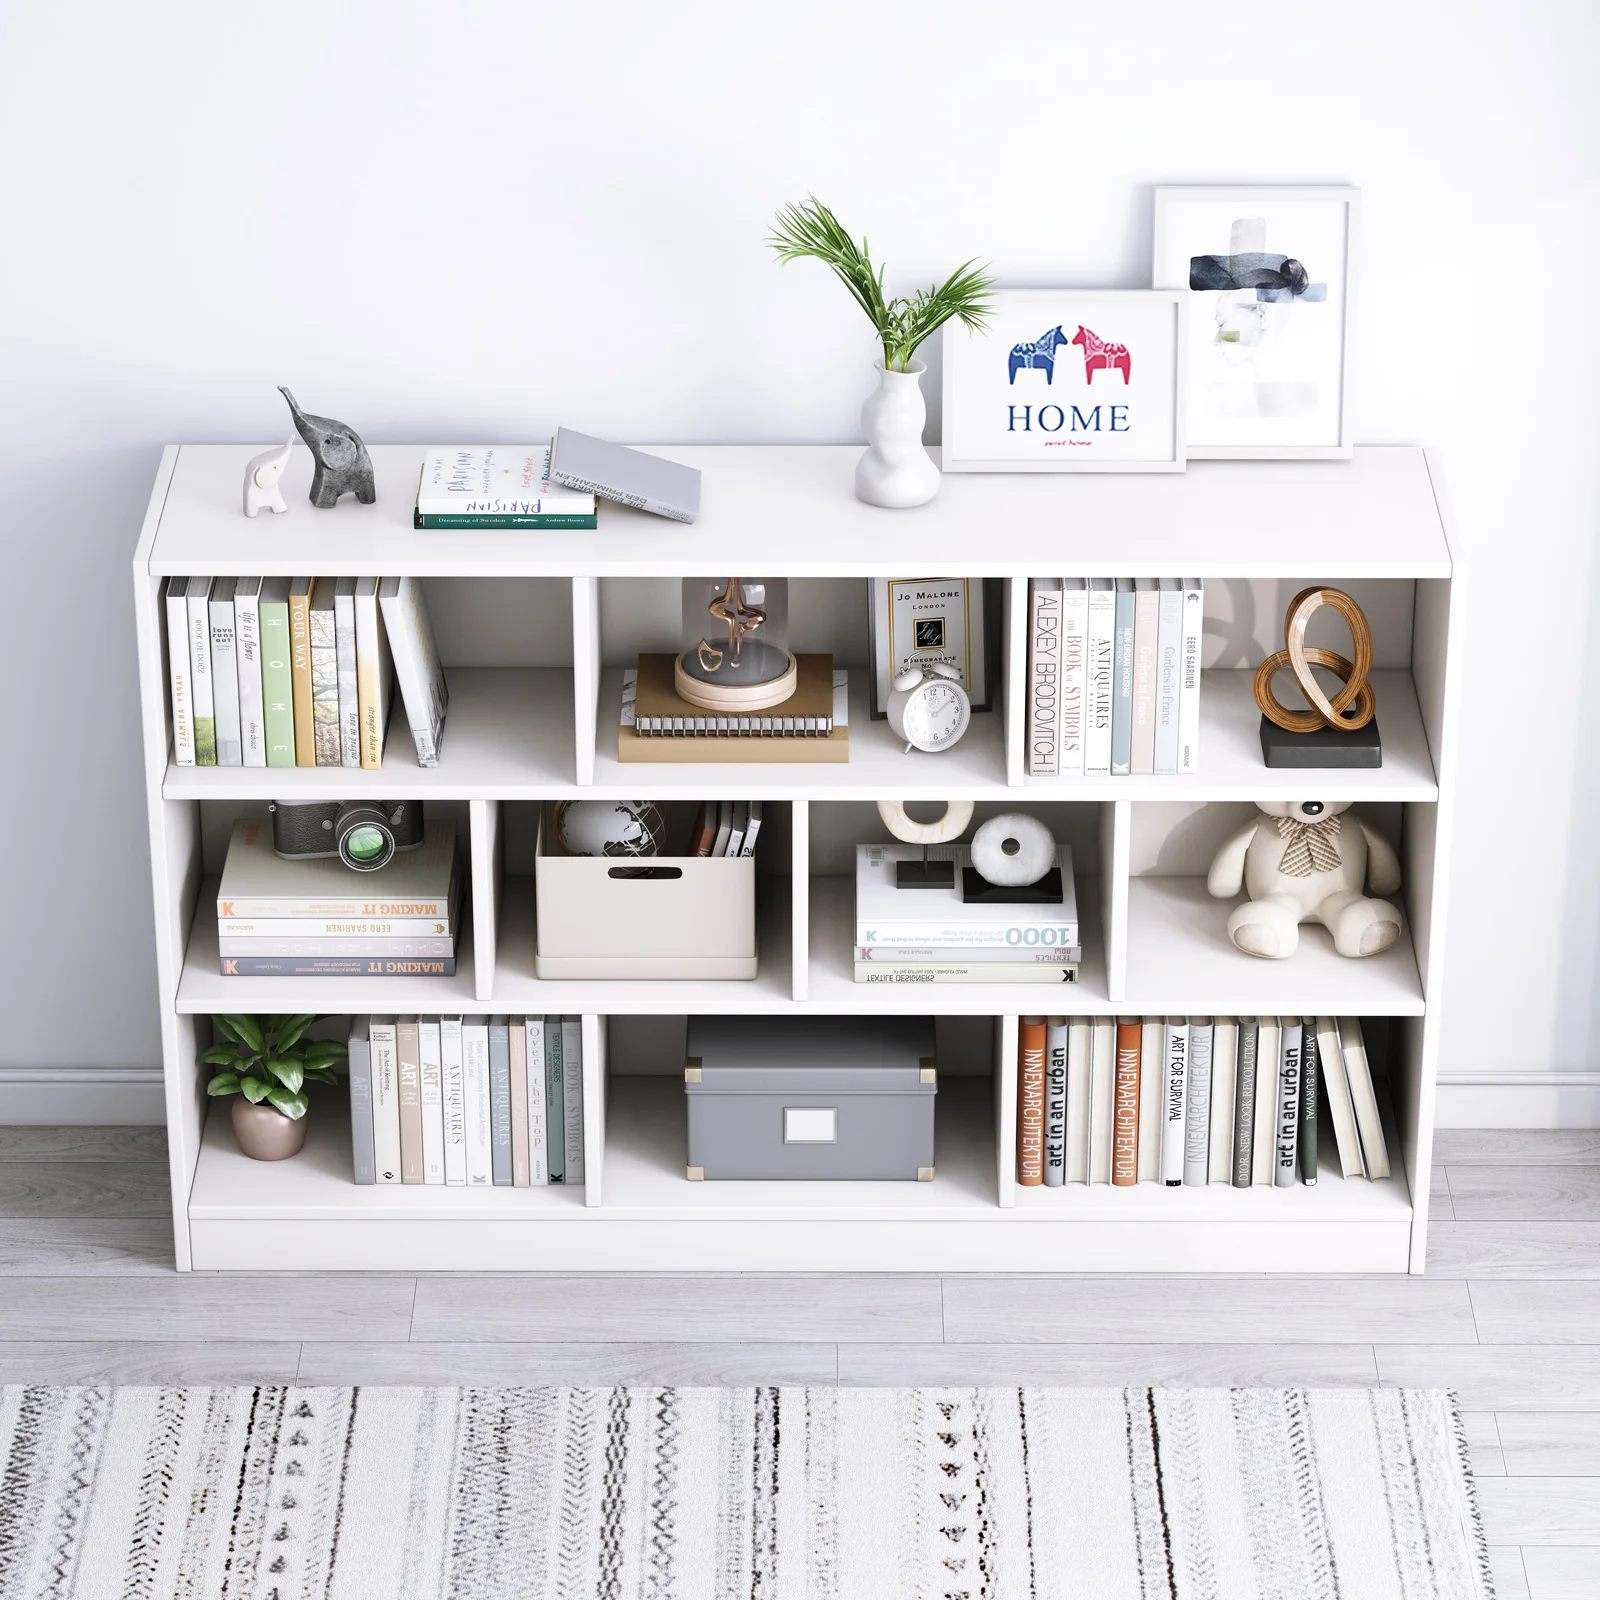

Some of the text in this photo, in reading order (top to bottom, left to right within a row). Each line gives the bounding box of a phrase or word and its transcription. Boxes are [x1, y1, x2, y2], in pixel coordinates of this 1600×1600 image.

[1007, 405, 1130, 432] HOME
[446, 453, 476, 491] PARISIAN
[555, 472, 648, 504] DER PRIMZAHLEN
[467, 499, 541, 514] PARISIAN
[561, 480, 644, 508] DIE EINSAMKEIT
[238, 612, 255, 623] life
[239, 638, 256, 661] flower
[292, 604, 307, 670] YOUR WAY
[1066, 635, 1082, 672] BOOK
[1034, 595, 1058, 765] ALEXEY BRODOVITCH
[1122, 628, 1132, 697] NEW URBAN HOUSING
[1138, 646, 1152, 682] Gardens
[1185, 637, 1196, 689] EERO SAARINEN
[930, 688, 937, 696] 12
[1094, 639, 1111, 729] ANTIQUAIRES
[1161, 646, 1176, 725] Gardens in France
[366, 706, 375, 733] stronger
[1064, 687, 1081, 751] SYMBOLS
[1138, 695, 1150, 725] France
[370, 736, 379, 750] than
[370, 753, 378, 763] sin
[362, 904, 377, 914] IT
[380, 904, 437, 914] MAKING
[326, 923, 391, 932] EERO SAARINEN
[1006, 927, 1070, 946] 1000
[368, 962, 444, 972] MAKING IT
[401, 1062, 416, 1088] ART
[423, 1062, 438, 1088] ART
[553, 1053, 561, 1082] DESIGNERS
[1169, 1035, 1184, 1121] ART FOR SURVIVAL
[1306, 1035, 1315, 1120] ART FOR SURVIVAL
[353, 1076, 368, 1099] ART
[449, 1063, 462, 1145] ANTIQUAIRES
[1187, 1035, 1210, 1164] INNENARCHITEKTUR
[495, 1067, 509, 1145] ANTIQUAIRES
[566, 1062, 580, 1163] BOOK SYMBOLS
[1022, 1048, 1043, 1178] INNENARCHITEKTUR
[1045, 1047, 1065, 1167] art in an urban
[1116, 1048, 1138, 1178] INNENARCHITEKTUR
[1238, 1032, 1255, 1181] DIOR. NEW LOOK REVOLUTION
[1278, 1048, 1298, 1168] art in an urban
